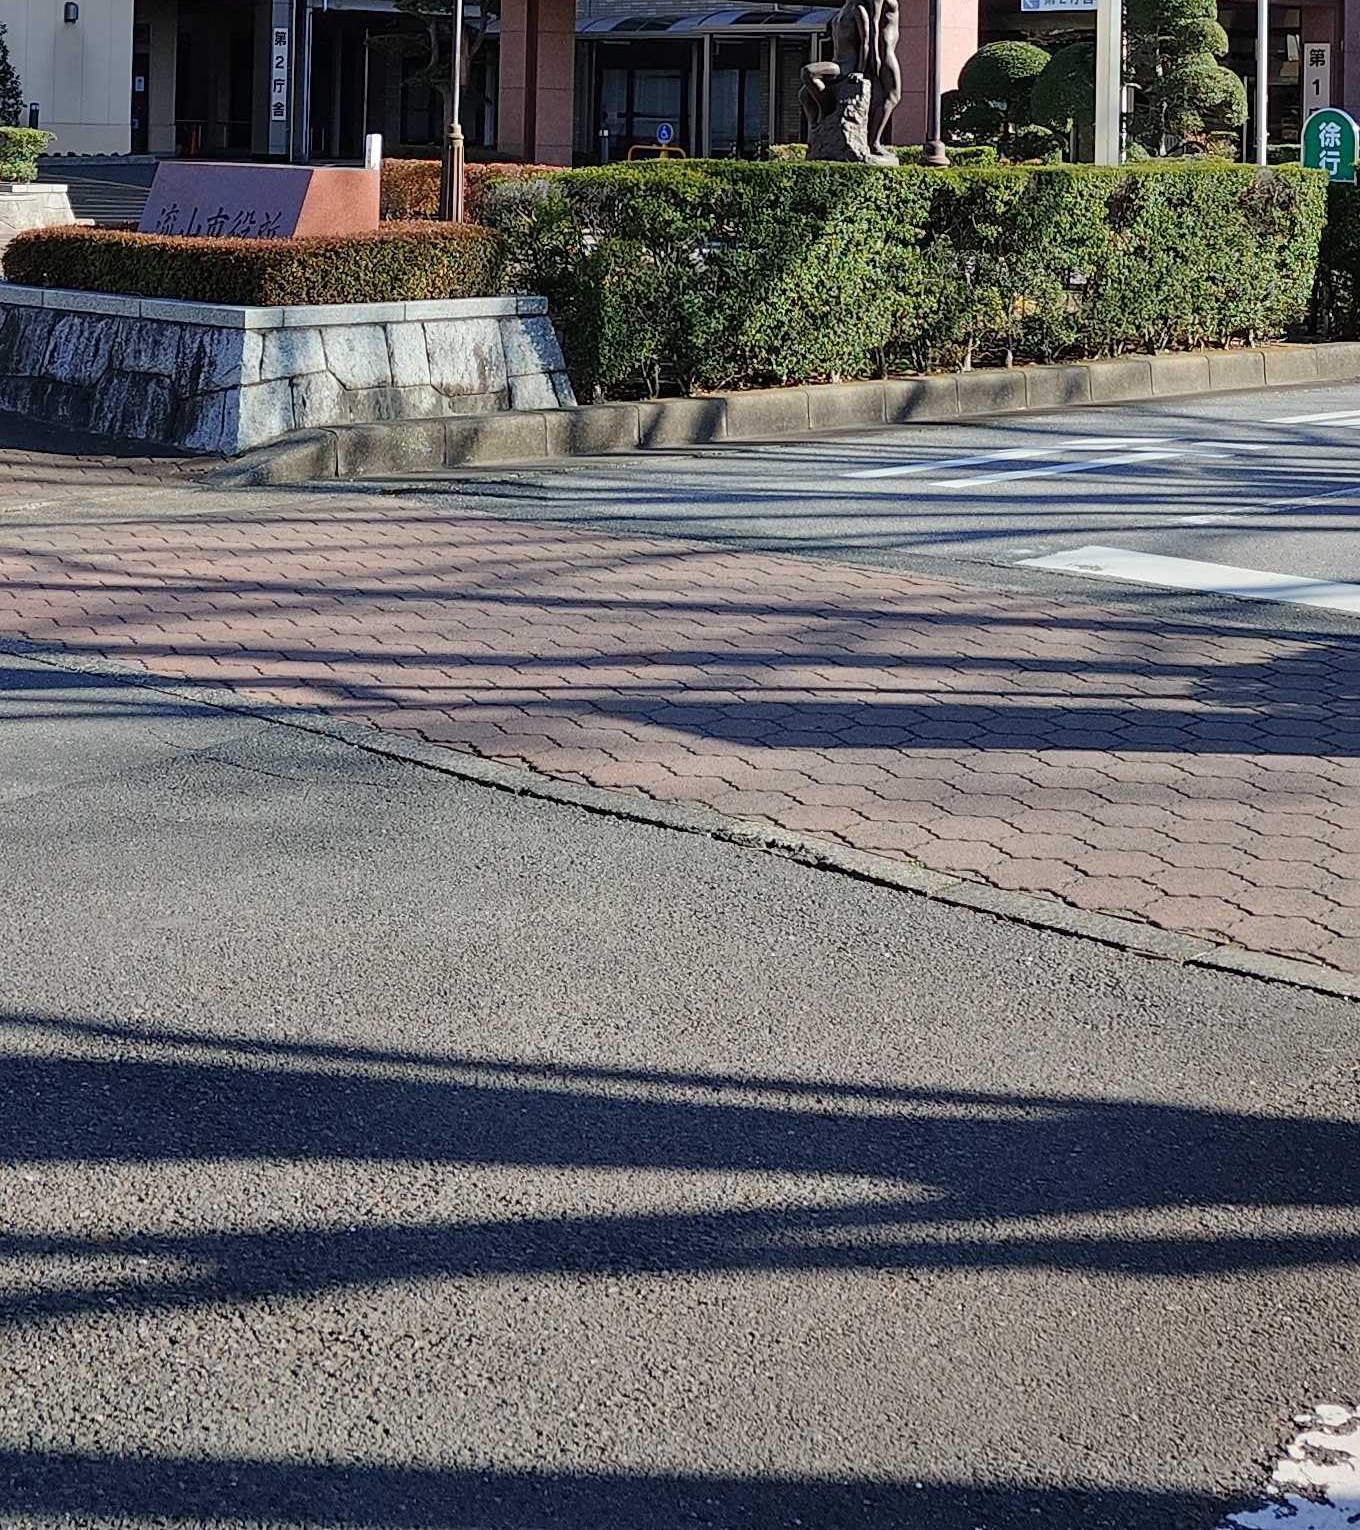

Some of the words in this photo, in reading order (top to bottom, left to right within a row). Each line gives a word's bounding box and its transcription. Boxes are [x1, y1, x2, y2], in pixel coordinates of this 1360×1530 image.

[272, 31, 287, 117] 第2庁舎
[1309, 48, 1325, 116] 第1
[1318, 121, 1342, 176] 徐行
